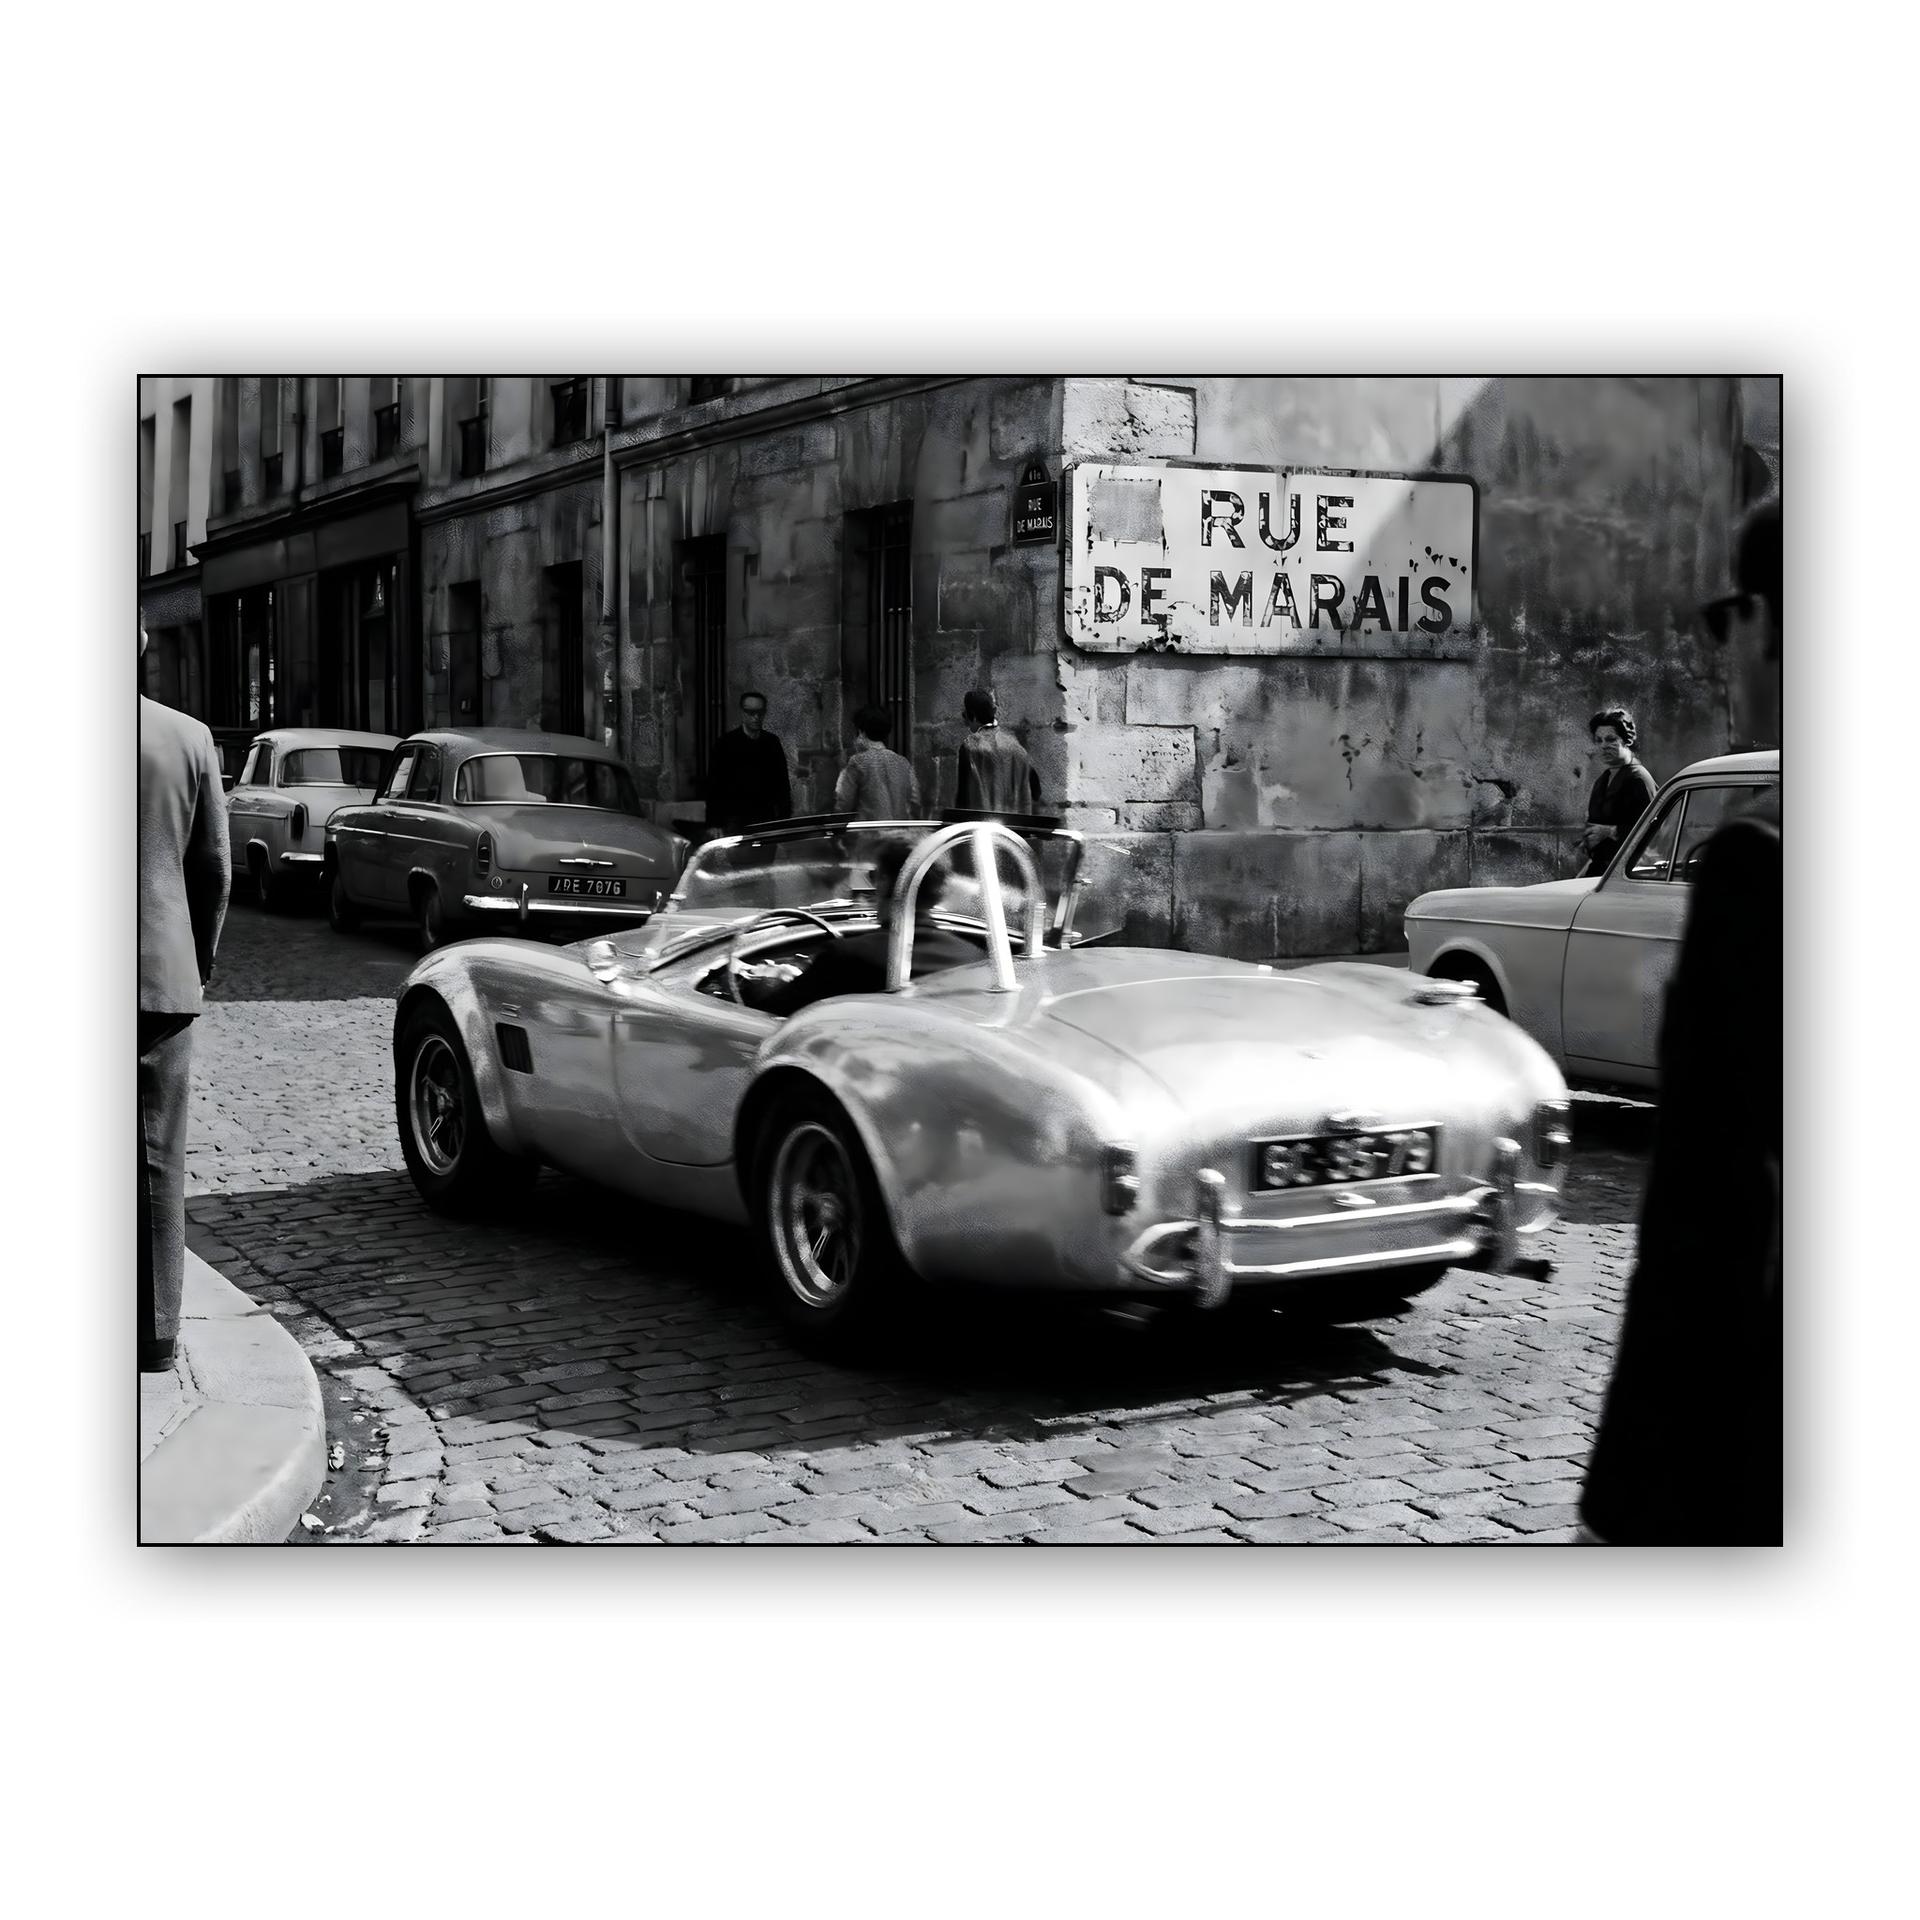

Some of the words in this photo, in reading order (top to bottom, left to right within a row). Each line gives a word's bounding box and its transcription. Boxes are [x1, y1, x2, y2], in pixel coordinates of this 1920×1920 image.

[1028, 497, 1042, 511] RUE
[1201, 489, 1354, 553] RUE
[1017, 519, 1026, 533] DE
[1094, 566, 1172, 626] DE
[1210, 570, 1453, 634] MARAIS
